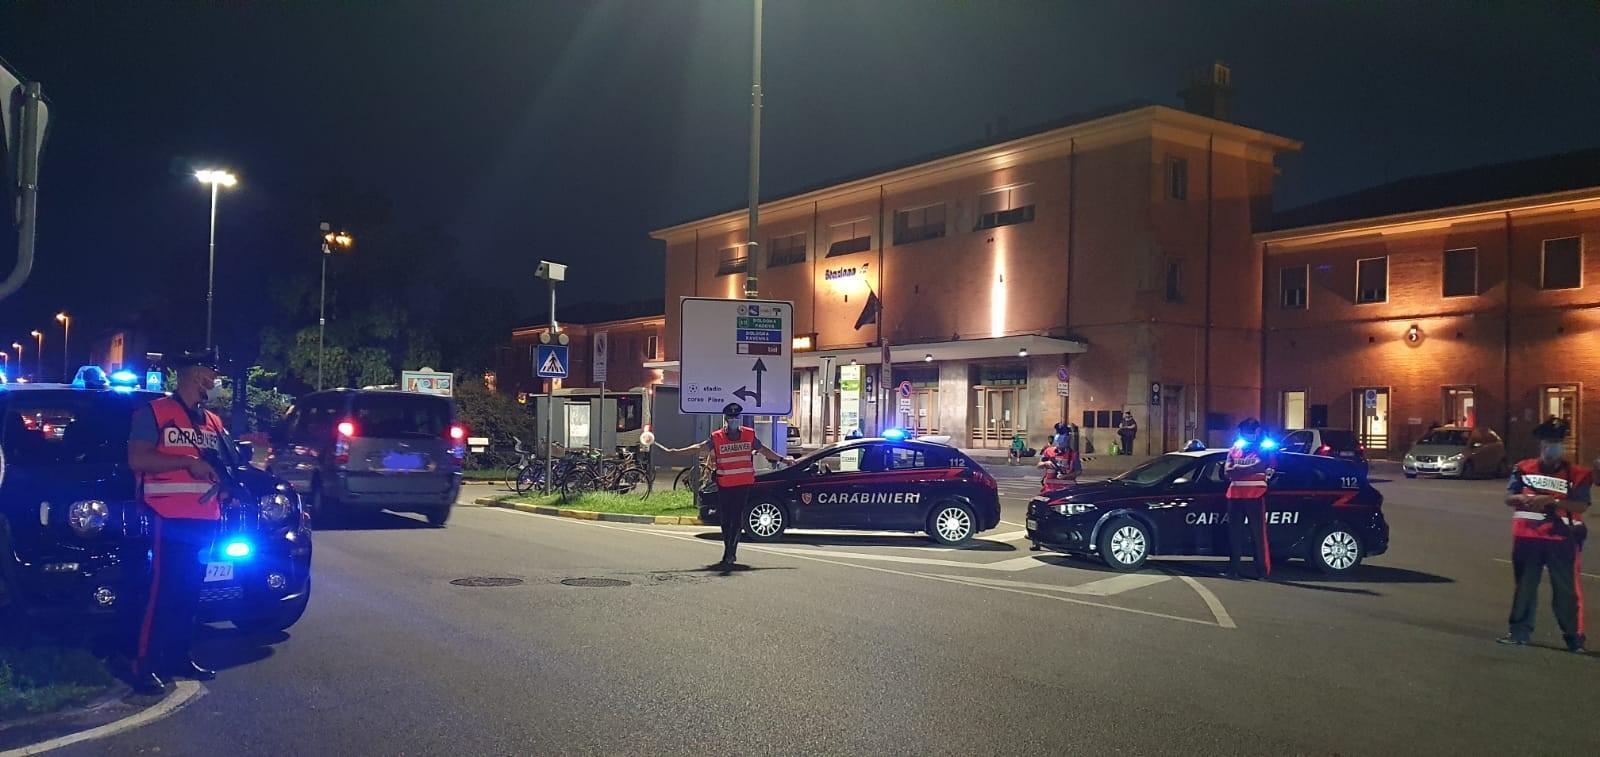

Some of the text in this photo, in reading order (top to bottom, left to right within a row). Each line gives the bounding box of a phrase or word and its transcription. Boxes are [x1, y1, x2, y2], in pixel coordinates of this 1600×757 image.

[949, 458, 966, 467] 112
[1341, 477, 1359, 487] 112
[817, 492, 921, 504] CARABINIERI
